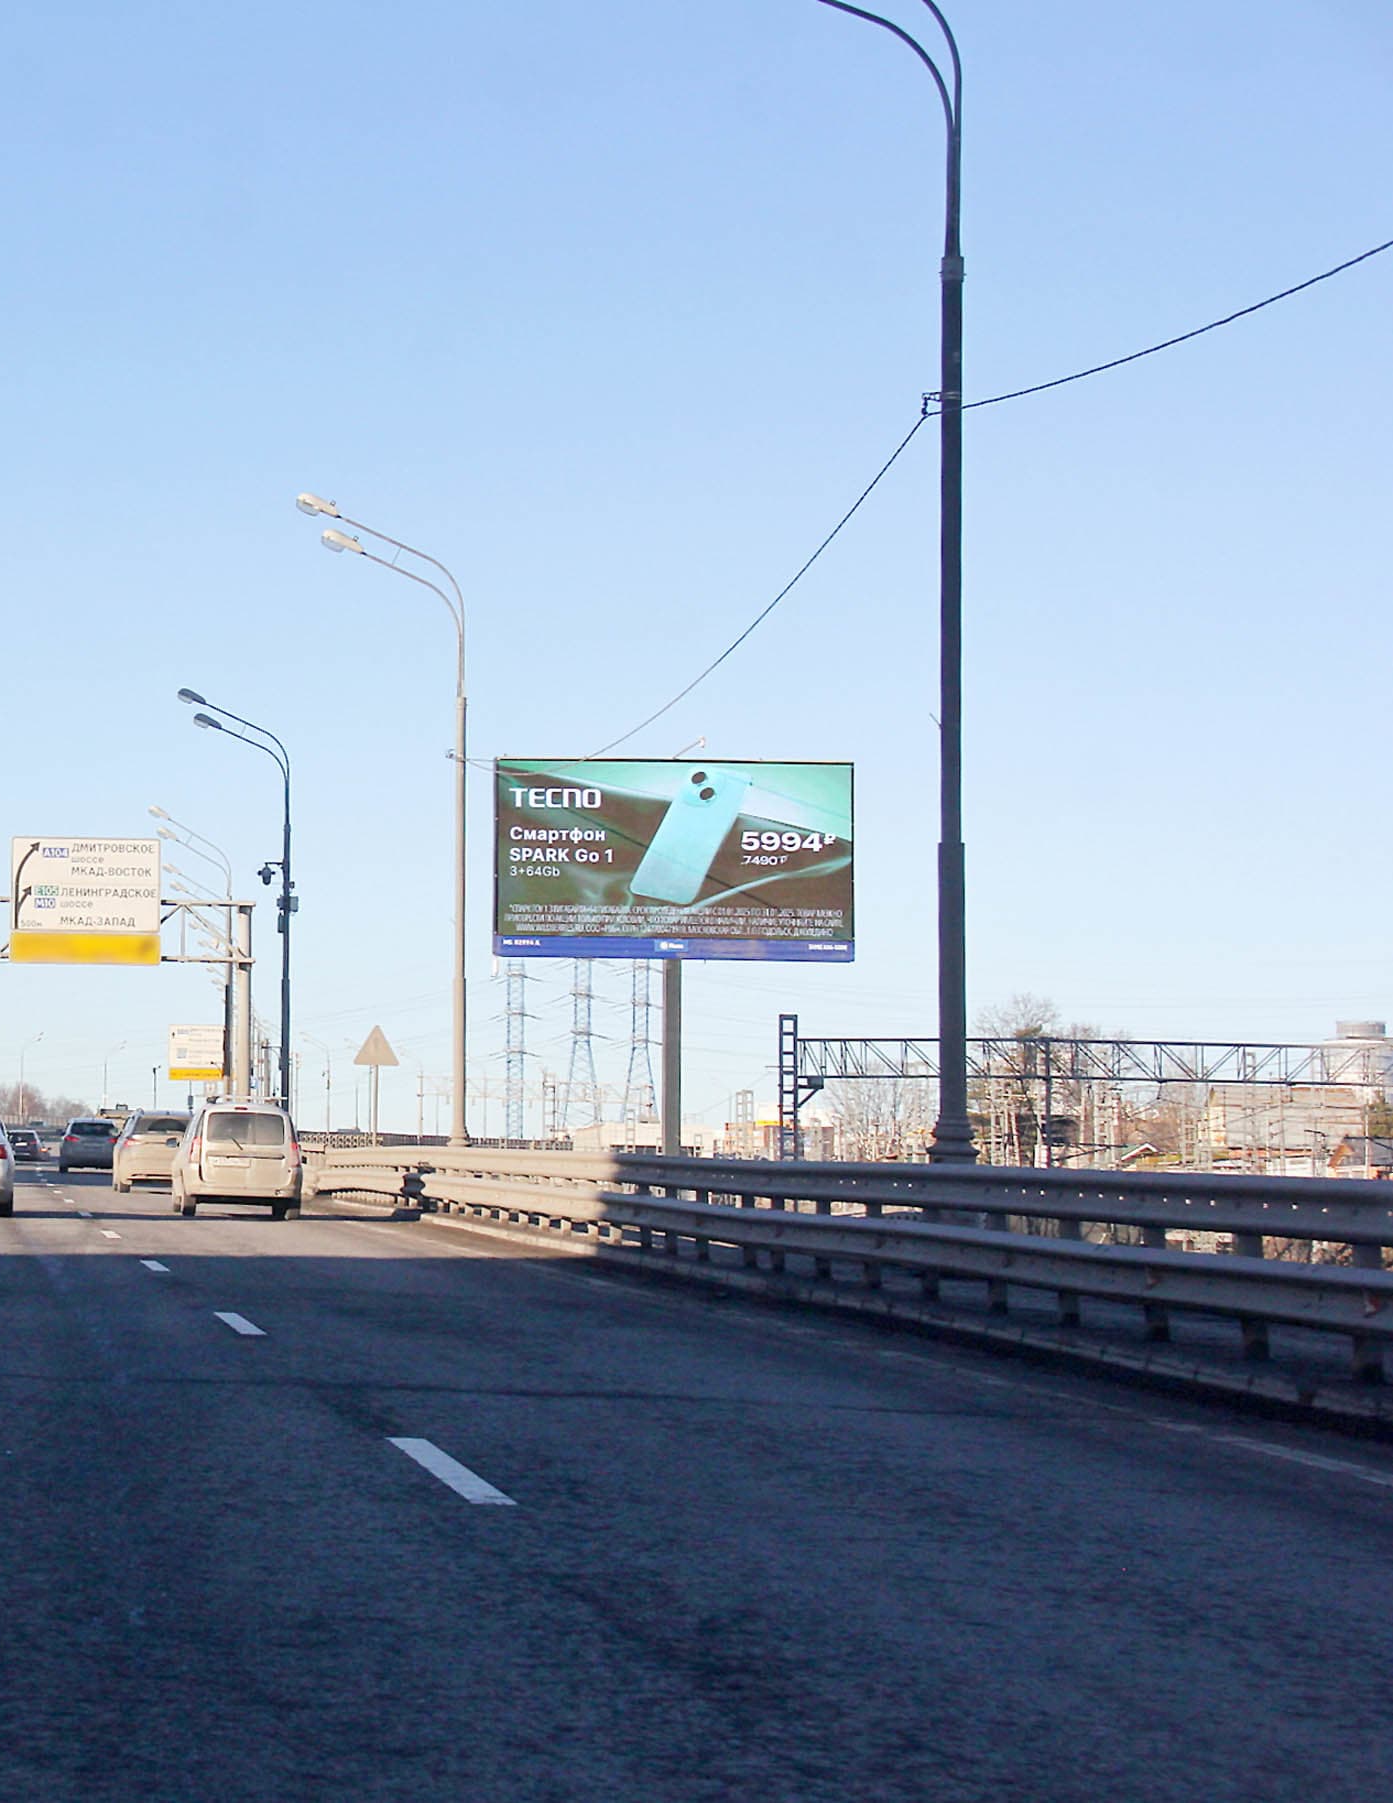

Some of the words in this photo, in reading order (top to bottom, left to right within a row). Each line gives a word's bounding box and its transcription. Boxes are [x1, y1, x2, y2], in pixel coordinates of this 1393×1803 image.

[509, 788, 602, 808] TECNO
[509, 826, 606, 844] Смартфон
[71, 843, 155, 854] ДМИТРОВСКОЕ
[509, 847, 570, 862] SPARK
[575, 848, 600, 862] Go
[604, 849, 614, 863] 1
[71, 866, 152, 877] МКАД-ВОСТОК
[509, 865, 561, 877] 3+64Gb
[60, 886, 157, 898] ЛЕНИНГРАДСКОЕ
[59, 916, 136, 927] МКАД-ЗАПАД
